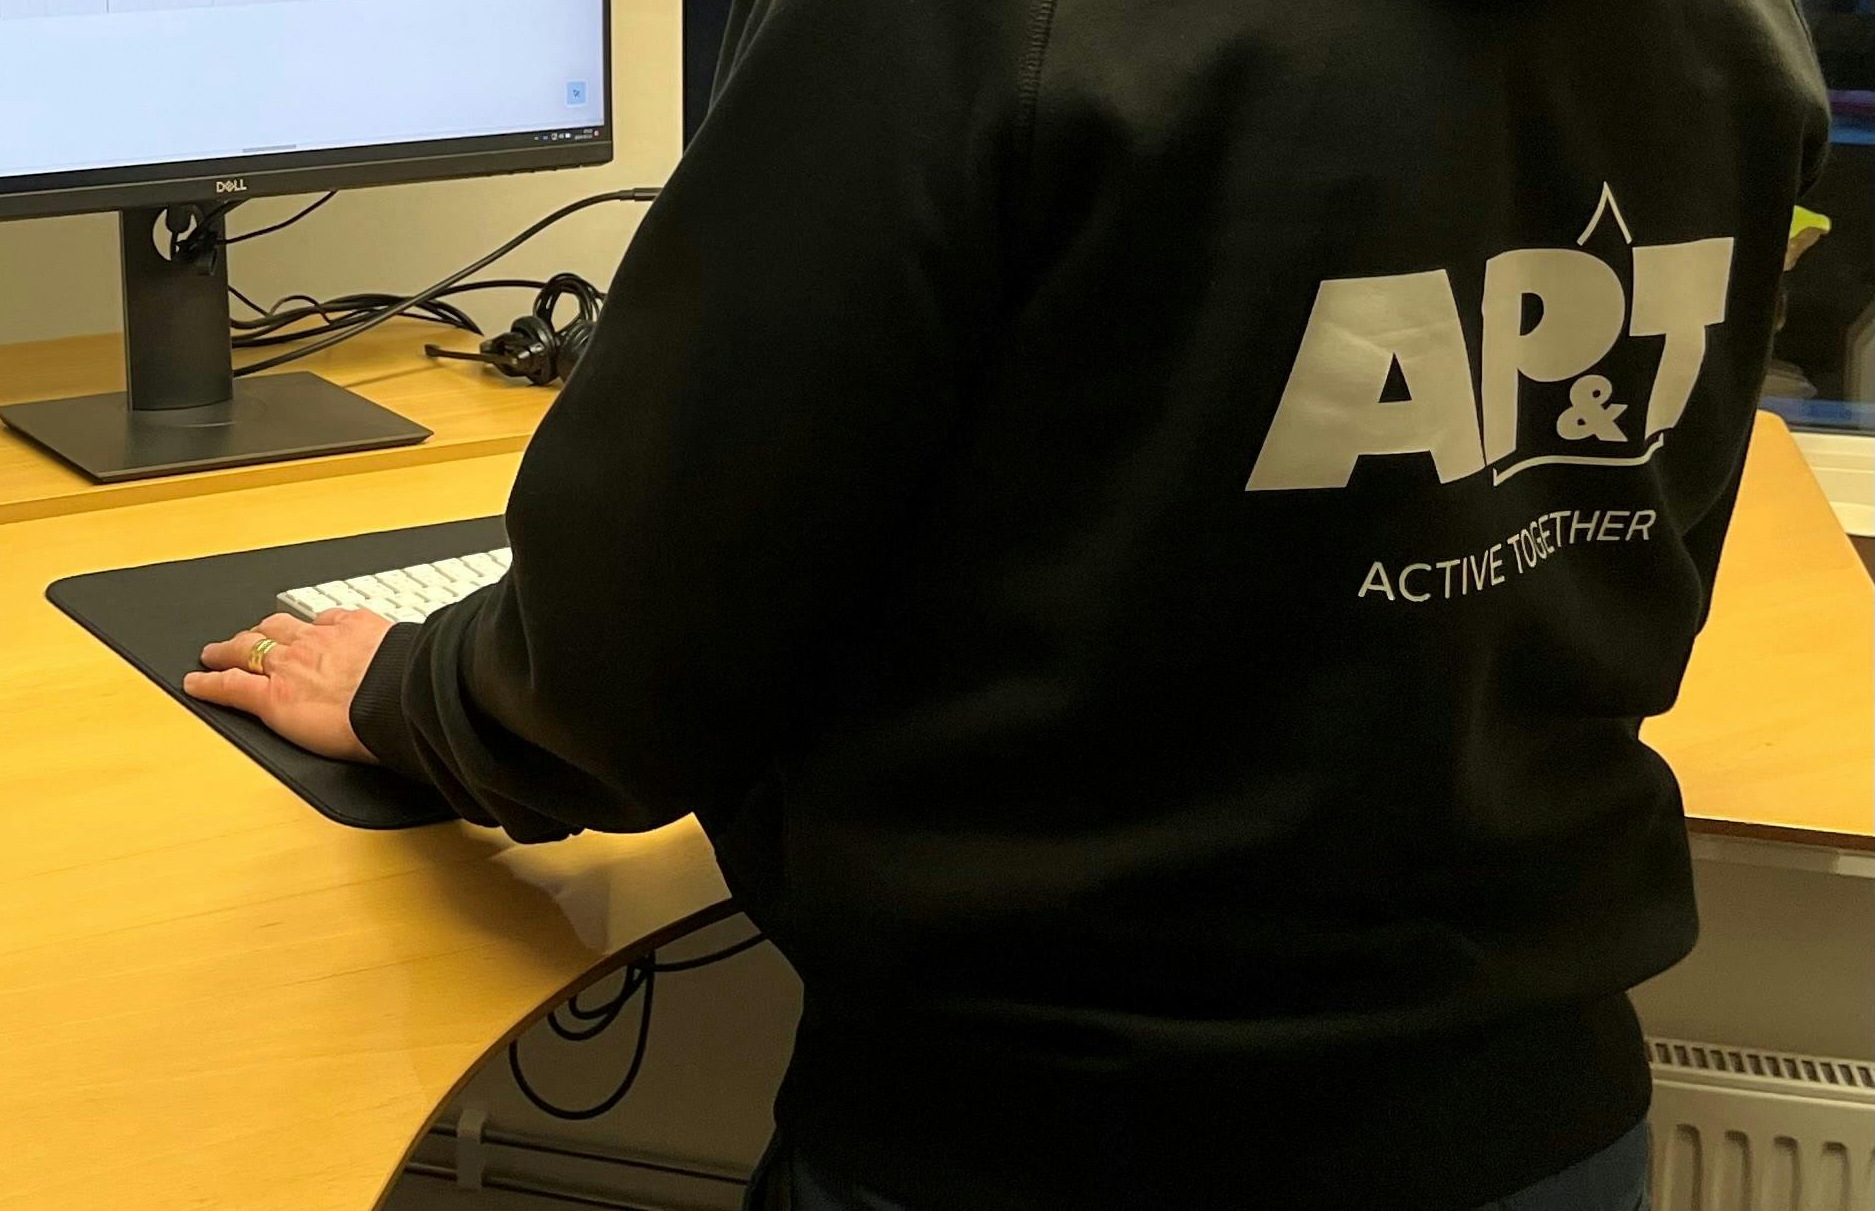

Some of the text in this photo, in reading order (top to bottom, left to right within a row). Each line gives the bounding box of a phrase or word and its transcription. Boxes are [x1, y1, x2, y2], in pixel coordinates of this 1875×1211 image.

[216, 178, 248, 194] DELL
[1245, 237, 1735, 492] AP&T
[1357, 508, 1657, 602] ACTIVE TOGETHER
